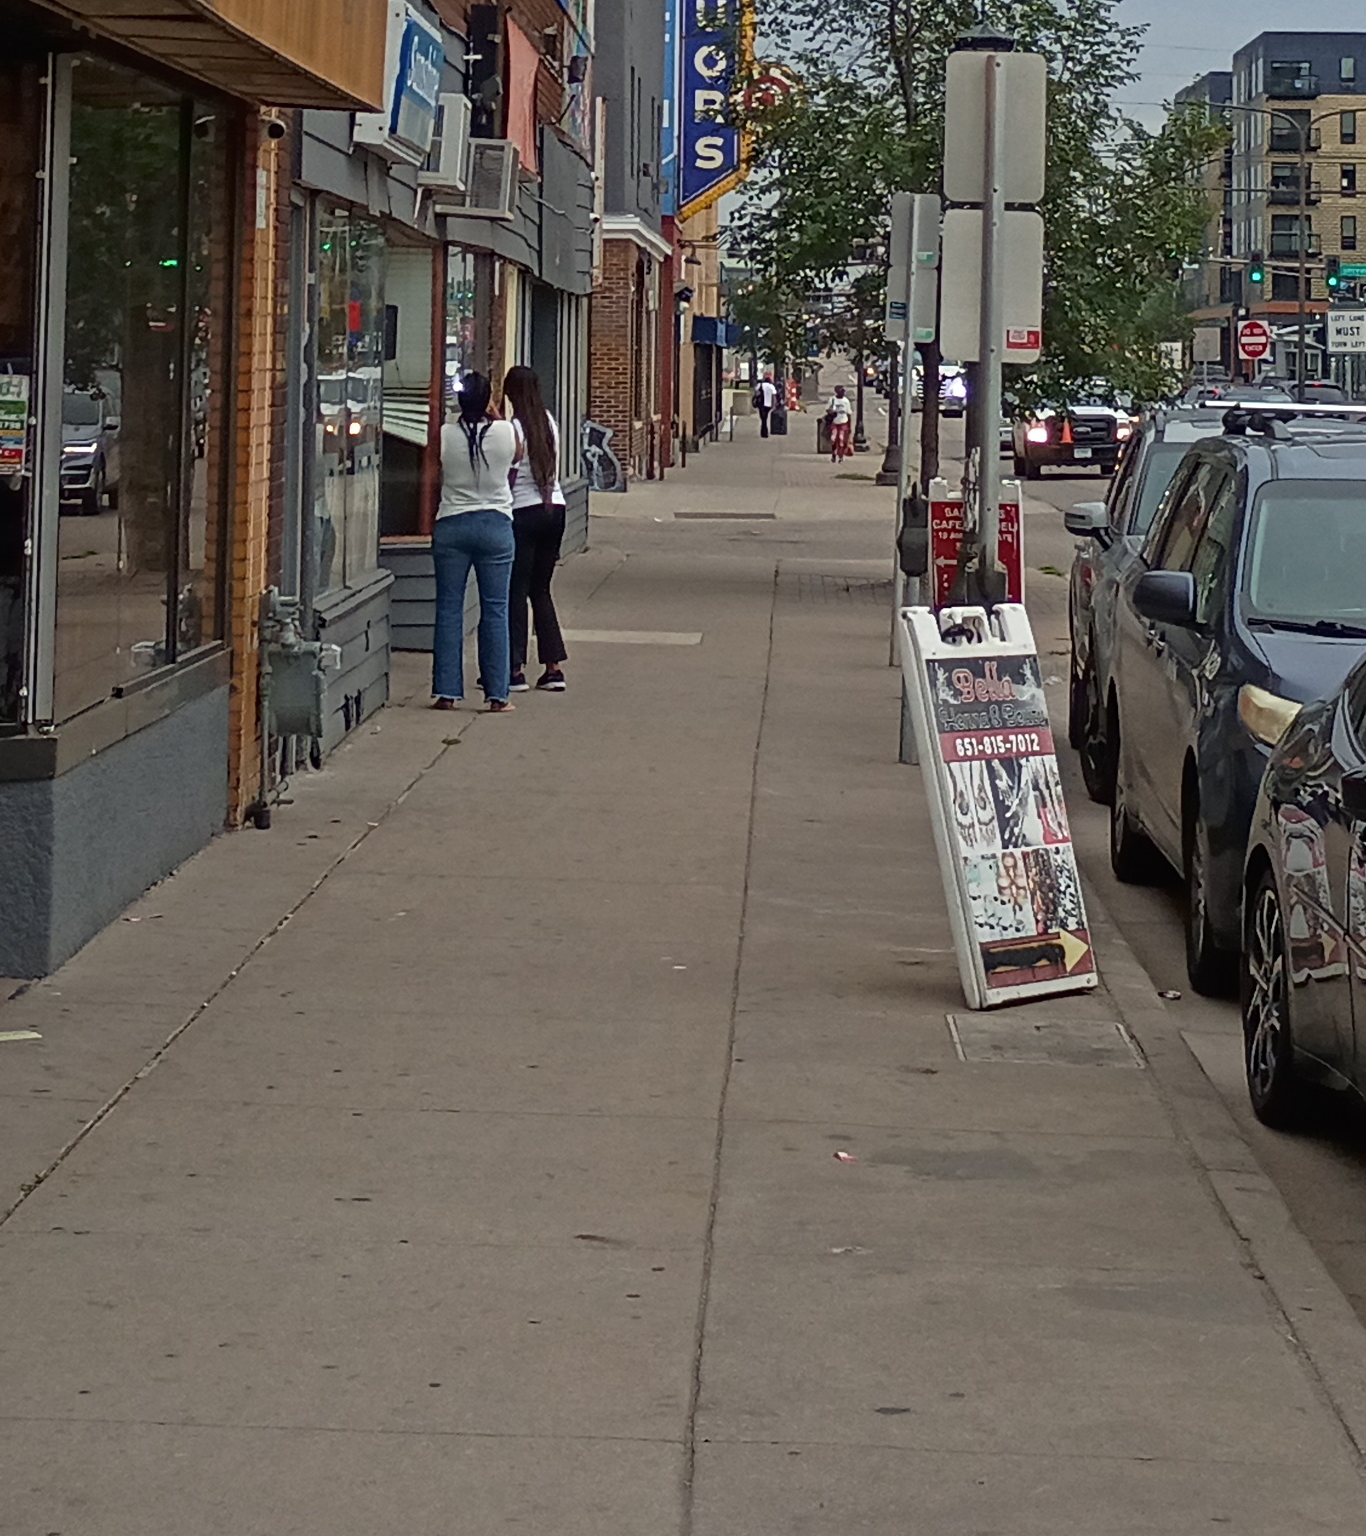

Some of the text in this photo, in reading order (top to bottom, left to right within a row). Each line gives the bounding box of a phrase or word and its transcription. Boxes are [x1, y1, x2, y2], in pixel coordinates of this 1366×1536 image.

[1335, 326, 1360, 336] MUST
[951, 661, 1017, 703] Bella
[955, 732, 1040, 757] 651-815-7012
